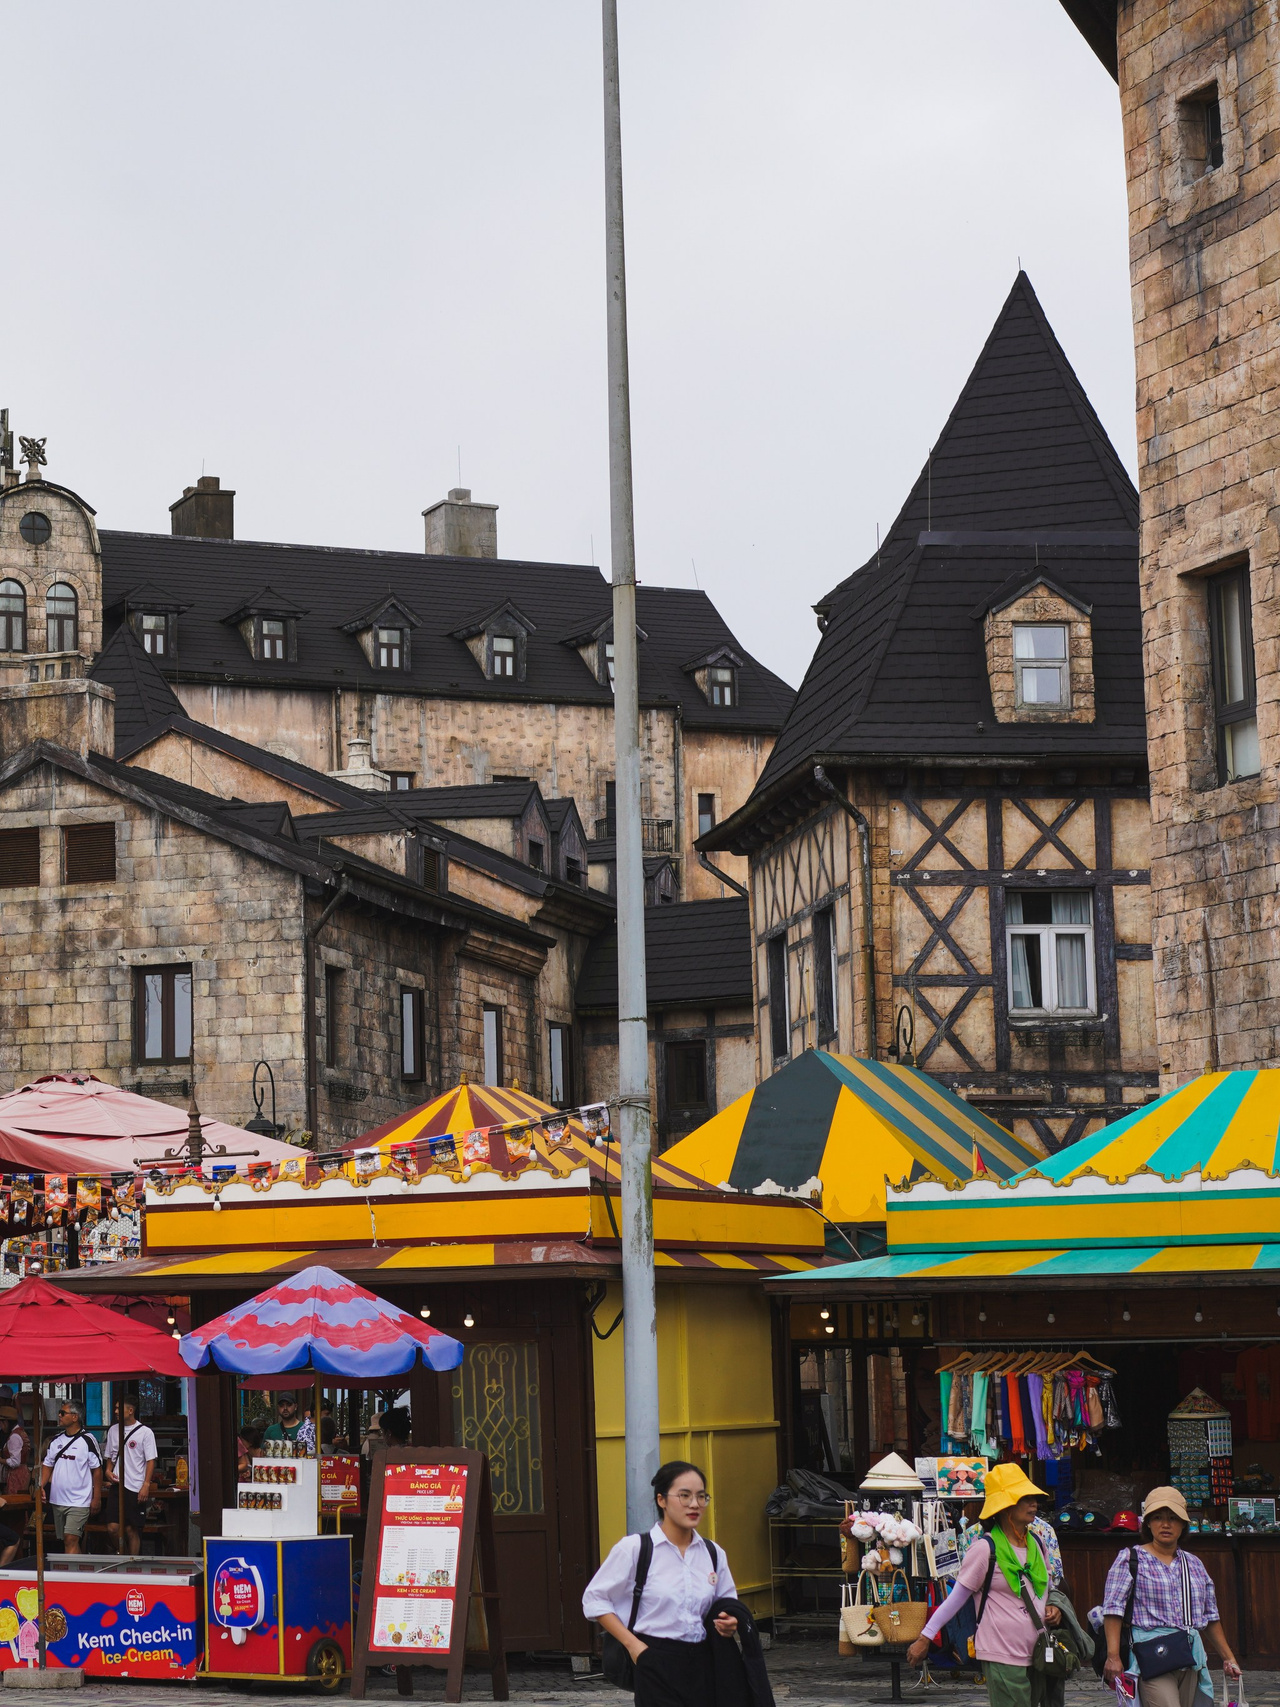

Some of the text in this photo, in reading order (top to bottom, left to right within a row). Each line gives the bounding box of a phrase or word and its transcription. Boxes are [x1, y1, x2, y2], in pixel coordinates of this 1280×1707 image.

[234, 1584, 251, 1594] KEM
[128, 1599, 143, 1607] KEM
[78, 1625, 193, 1649] Kem Check-in
[101, 1648, 174, 1665] Ice-Cream
